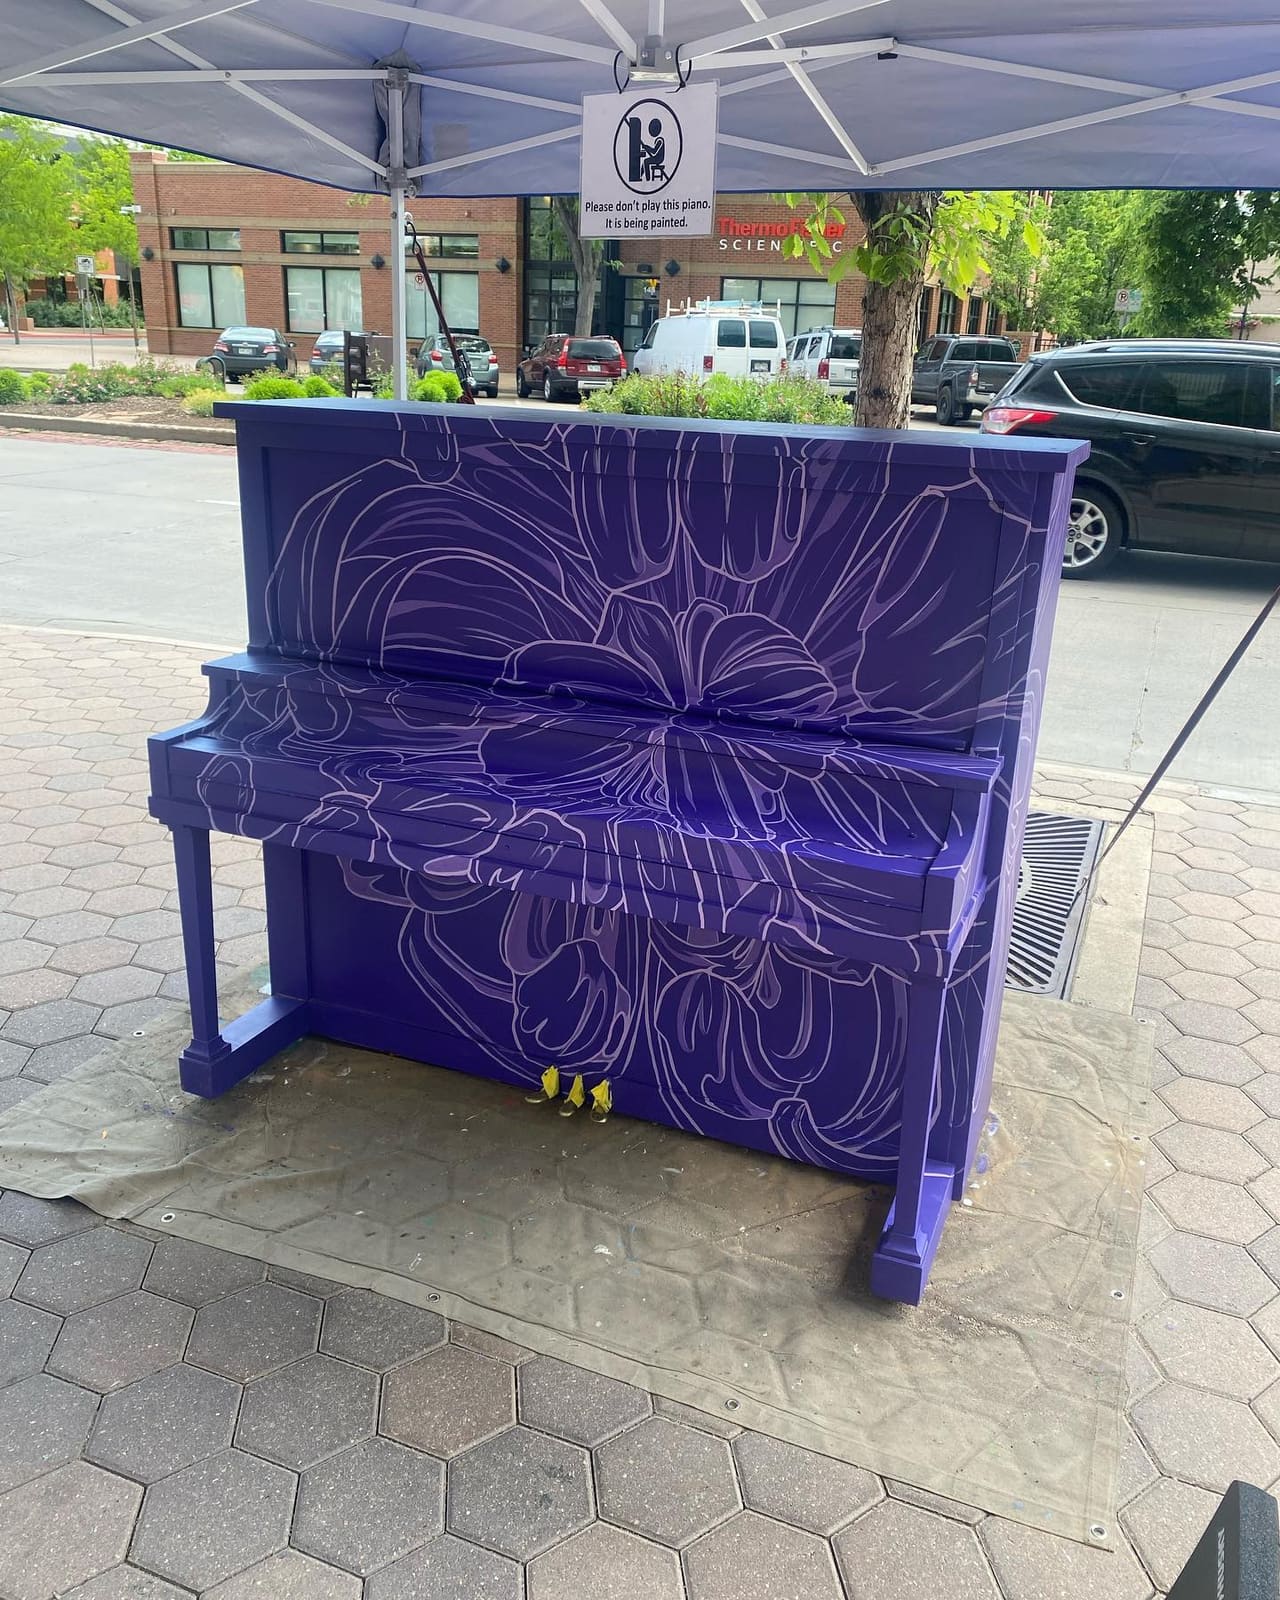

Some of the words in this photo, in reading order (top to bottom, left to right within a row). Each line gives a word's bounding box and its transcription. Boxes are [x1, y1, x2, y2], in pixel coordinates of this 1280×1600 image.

[585, 201, 614, 212] Please
[616, 200, 640, 212] don't
[641, 199, 661, 213] play
[663, 198, 680, 211] this
[682, 198, 711, 212] piano.
[605, 218, 613, 229] It
[614, 217, 622, 229] is
[624, 217, 649, 231] being
[650, 216, 688, 230] painted.
[718, 216, 846, 237] ThermoFier
[719, 239, 842, 252] SCIENFC
